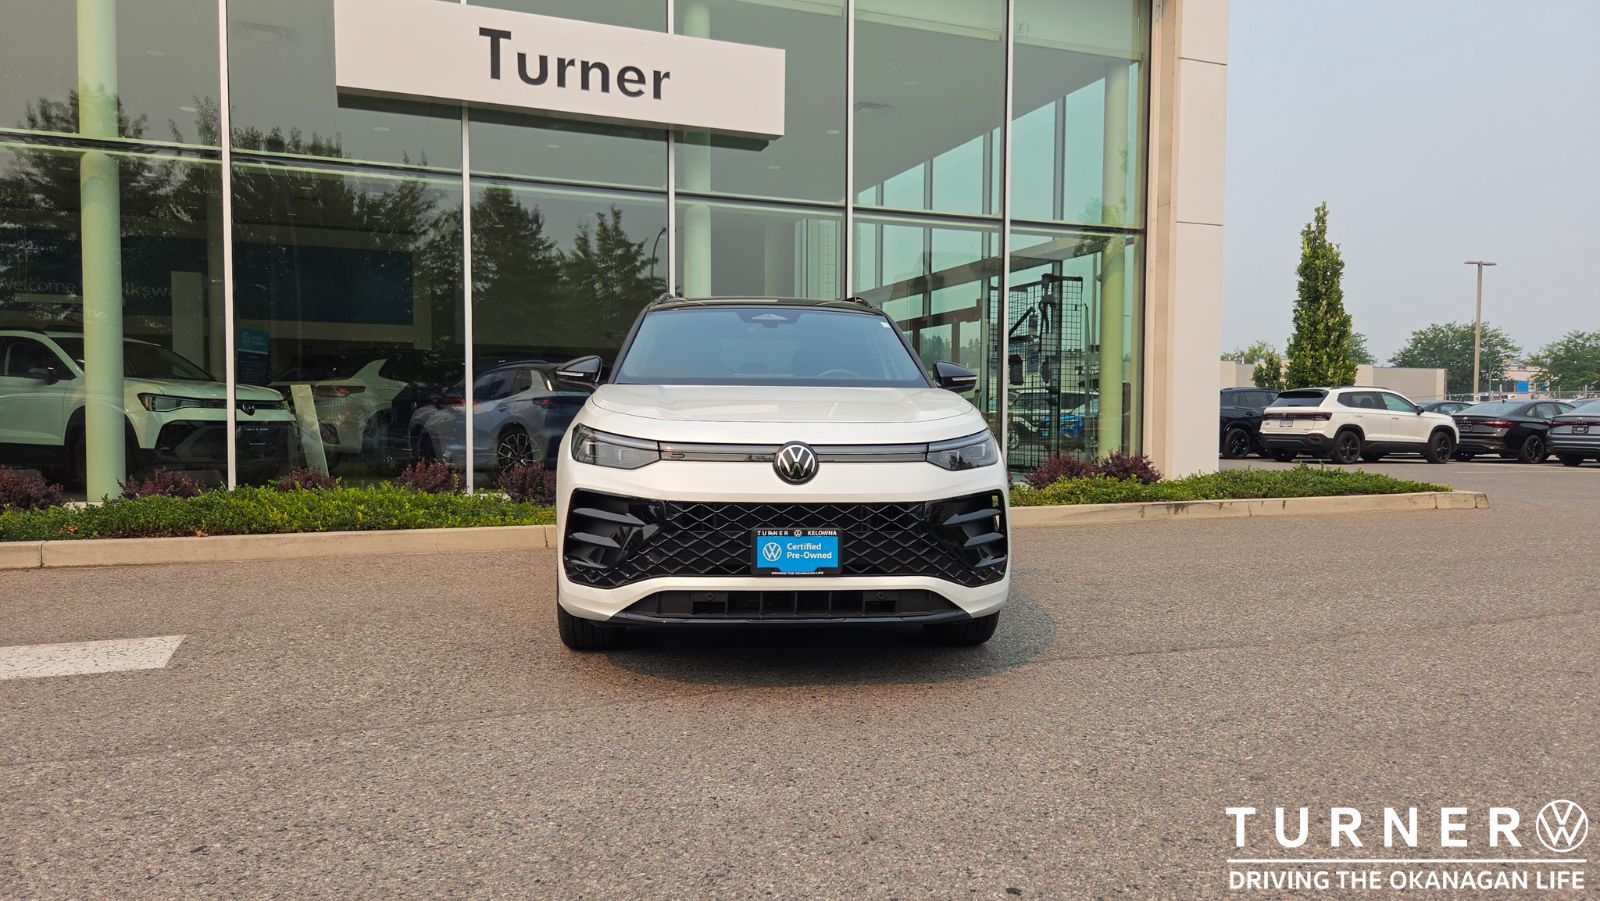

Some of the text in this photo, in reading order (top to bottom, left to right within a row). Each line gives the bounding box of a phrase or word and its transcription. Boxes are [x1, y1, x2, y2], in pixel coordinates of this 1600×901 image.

[479, 27, 671, 100] Turner
[786, 542, 822, 550] Certified
[786, 551, 832, 559] Pre-Owned
